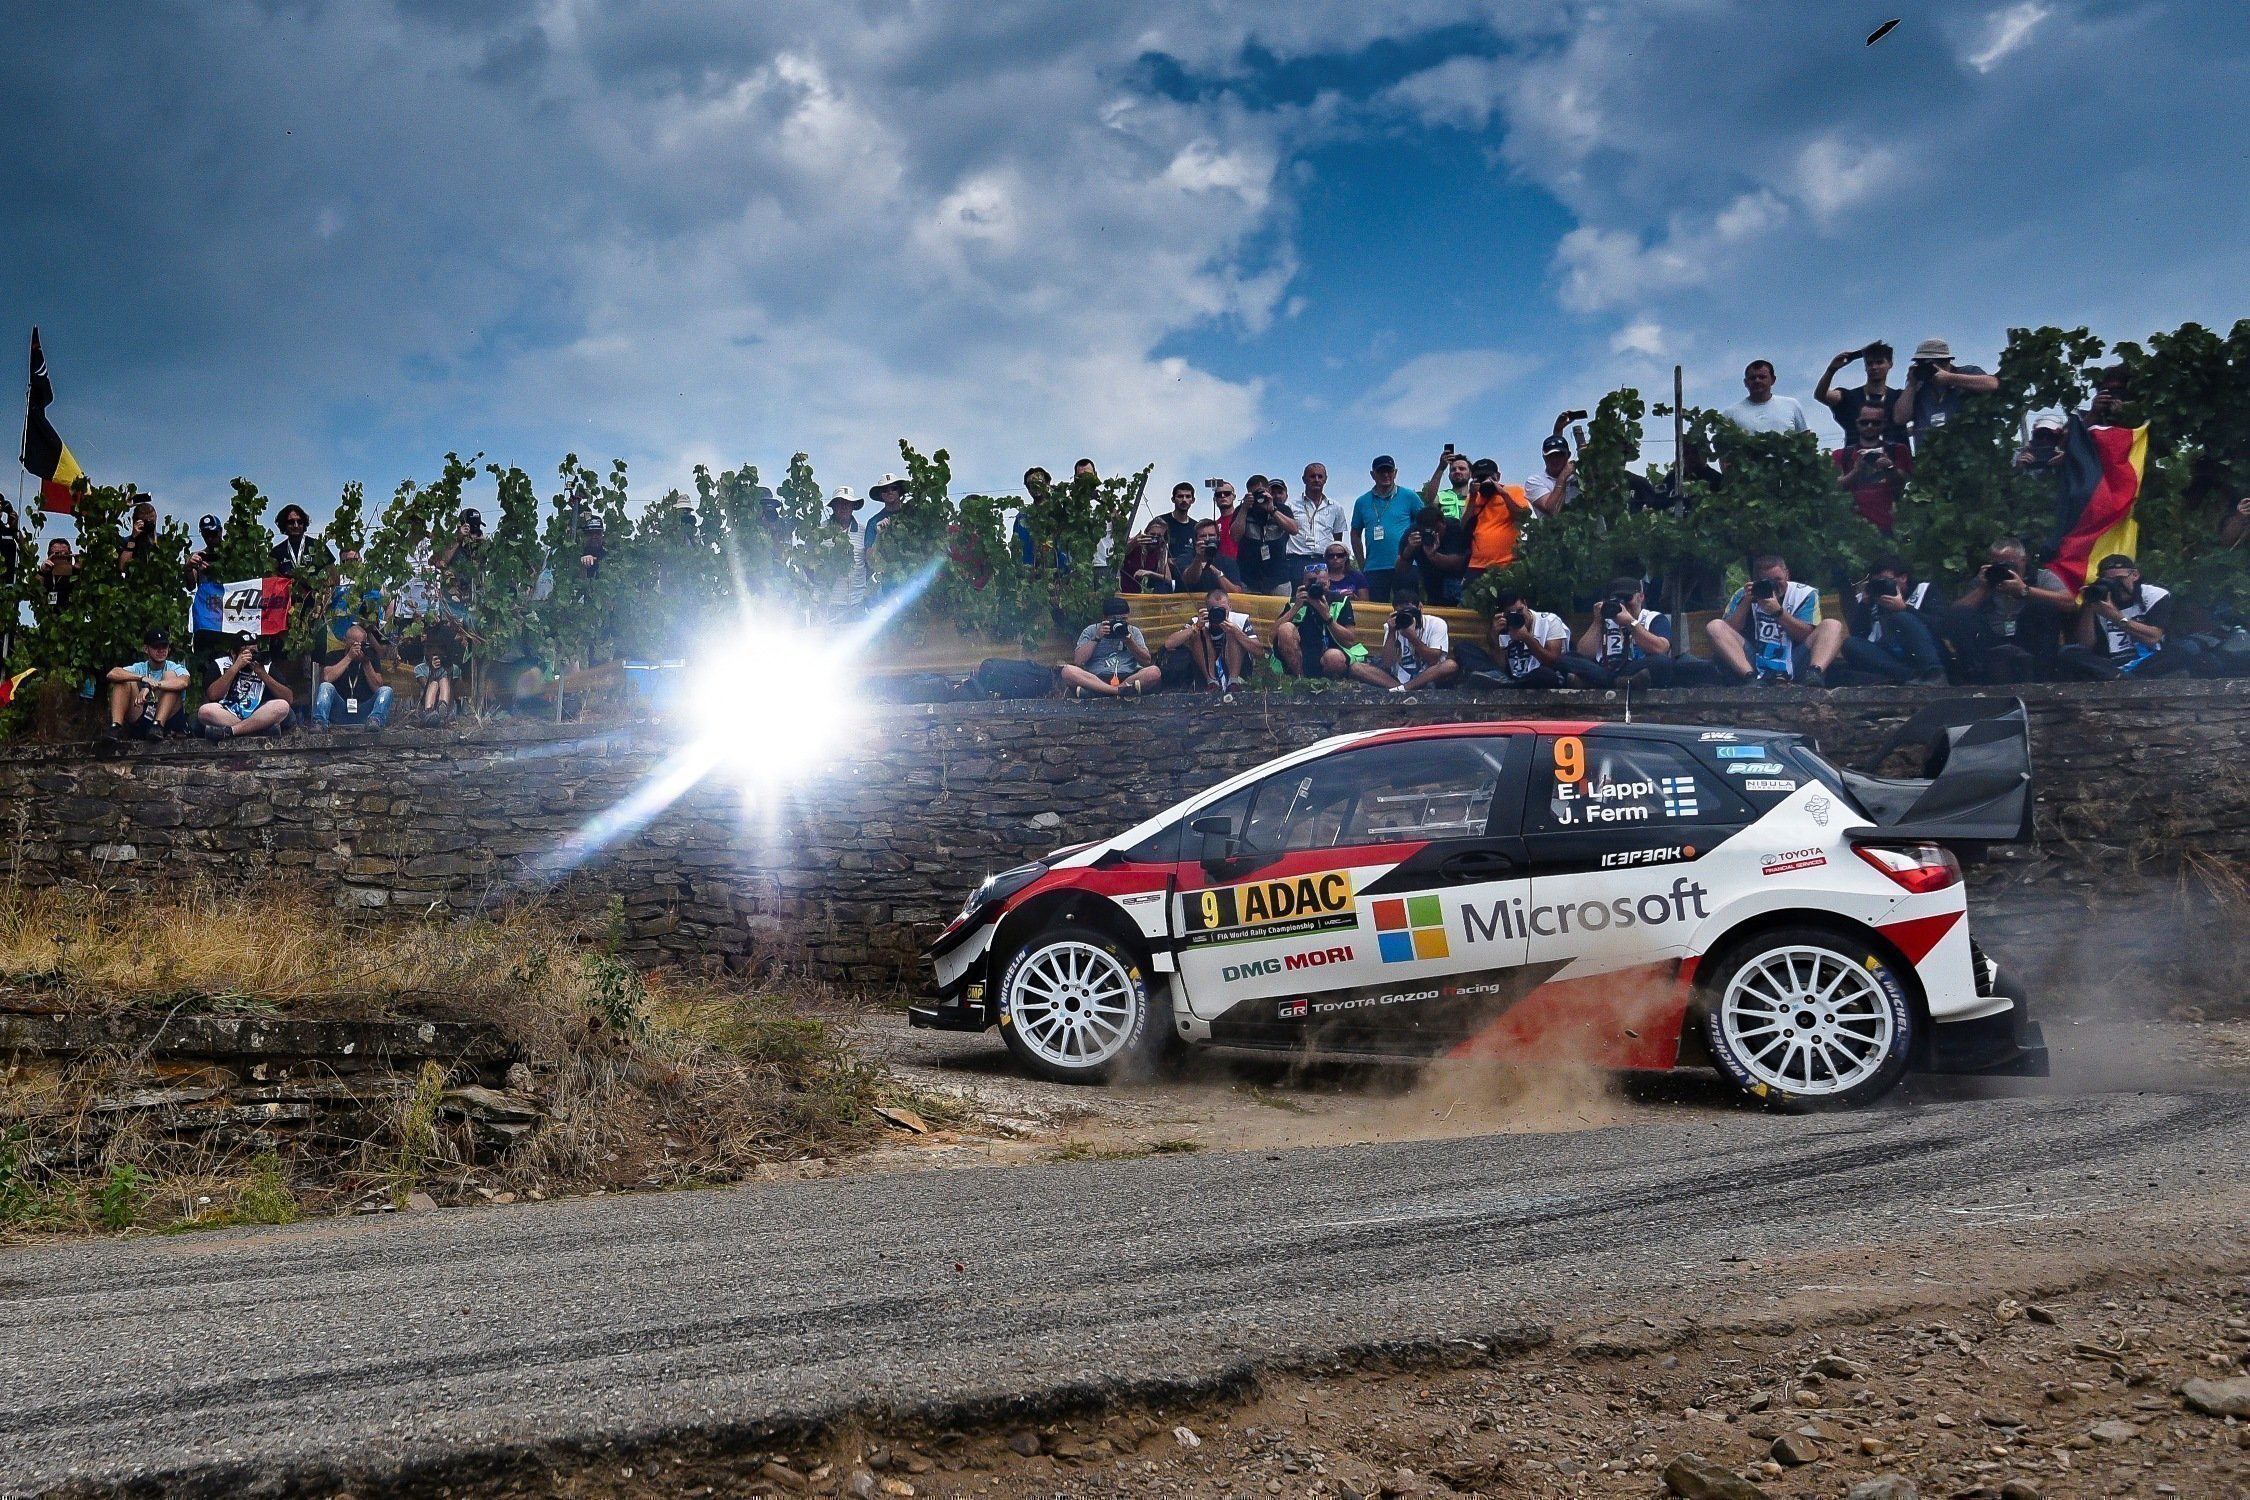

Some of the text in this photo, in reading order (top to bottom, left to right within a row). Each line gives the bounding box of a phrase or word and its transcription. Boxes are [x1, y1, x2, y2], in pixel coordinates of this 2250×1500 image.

[1554, 736, 1585, 782] 9
[1558, 779, 1653, 800] E. Lappi
[1558, 805, 1648, 824] J. Ferm
[1778, 848, 1823, 860] TOYOTA
[1201, 874, 1347, 928] 9 ADAC
[1461, 877, 1710, 943] Microsoft
[1230, 930, 1248, 939] World
[1250, 928, 1266, 936] Rally
[1268, 922, 1314, 934] Championship
[1001, 950, 1026, 1004] MICHELIN
[1222, 946, 1354, 982] DMG MORI
[967, 987, 983, 999] OMP
[1279, 1005, 1306, 1017] GR
[1312, 998, 1376, 1012] TOYOTA
[1380, 990, 1439, 1004] GAZOO
[1128, 990, 1145, 1049] MICHELIN
[1711, 1013, 1746, 1076] MICHELIN
